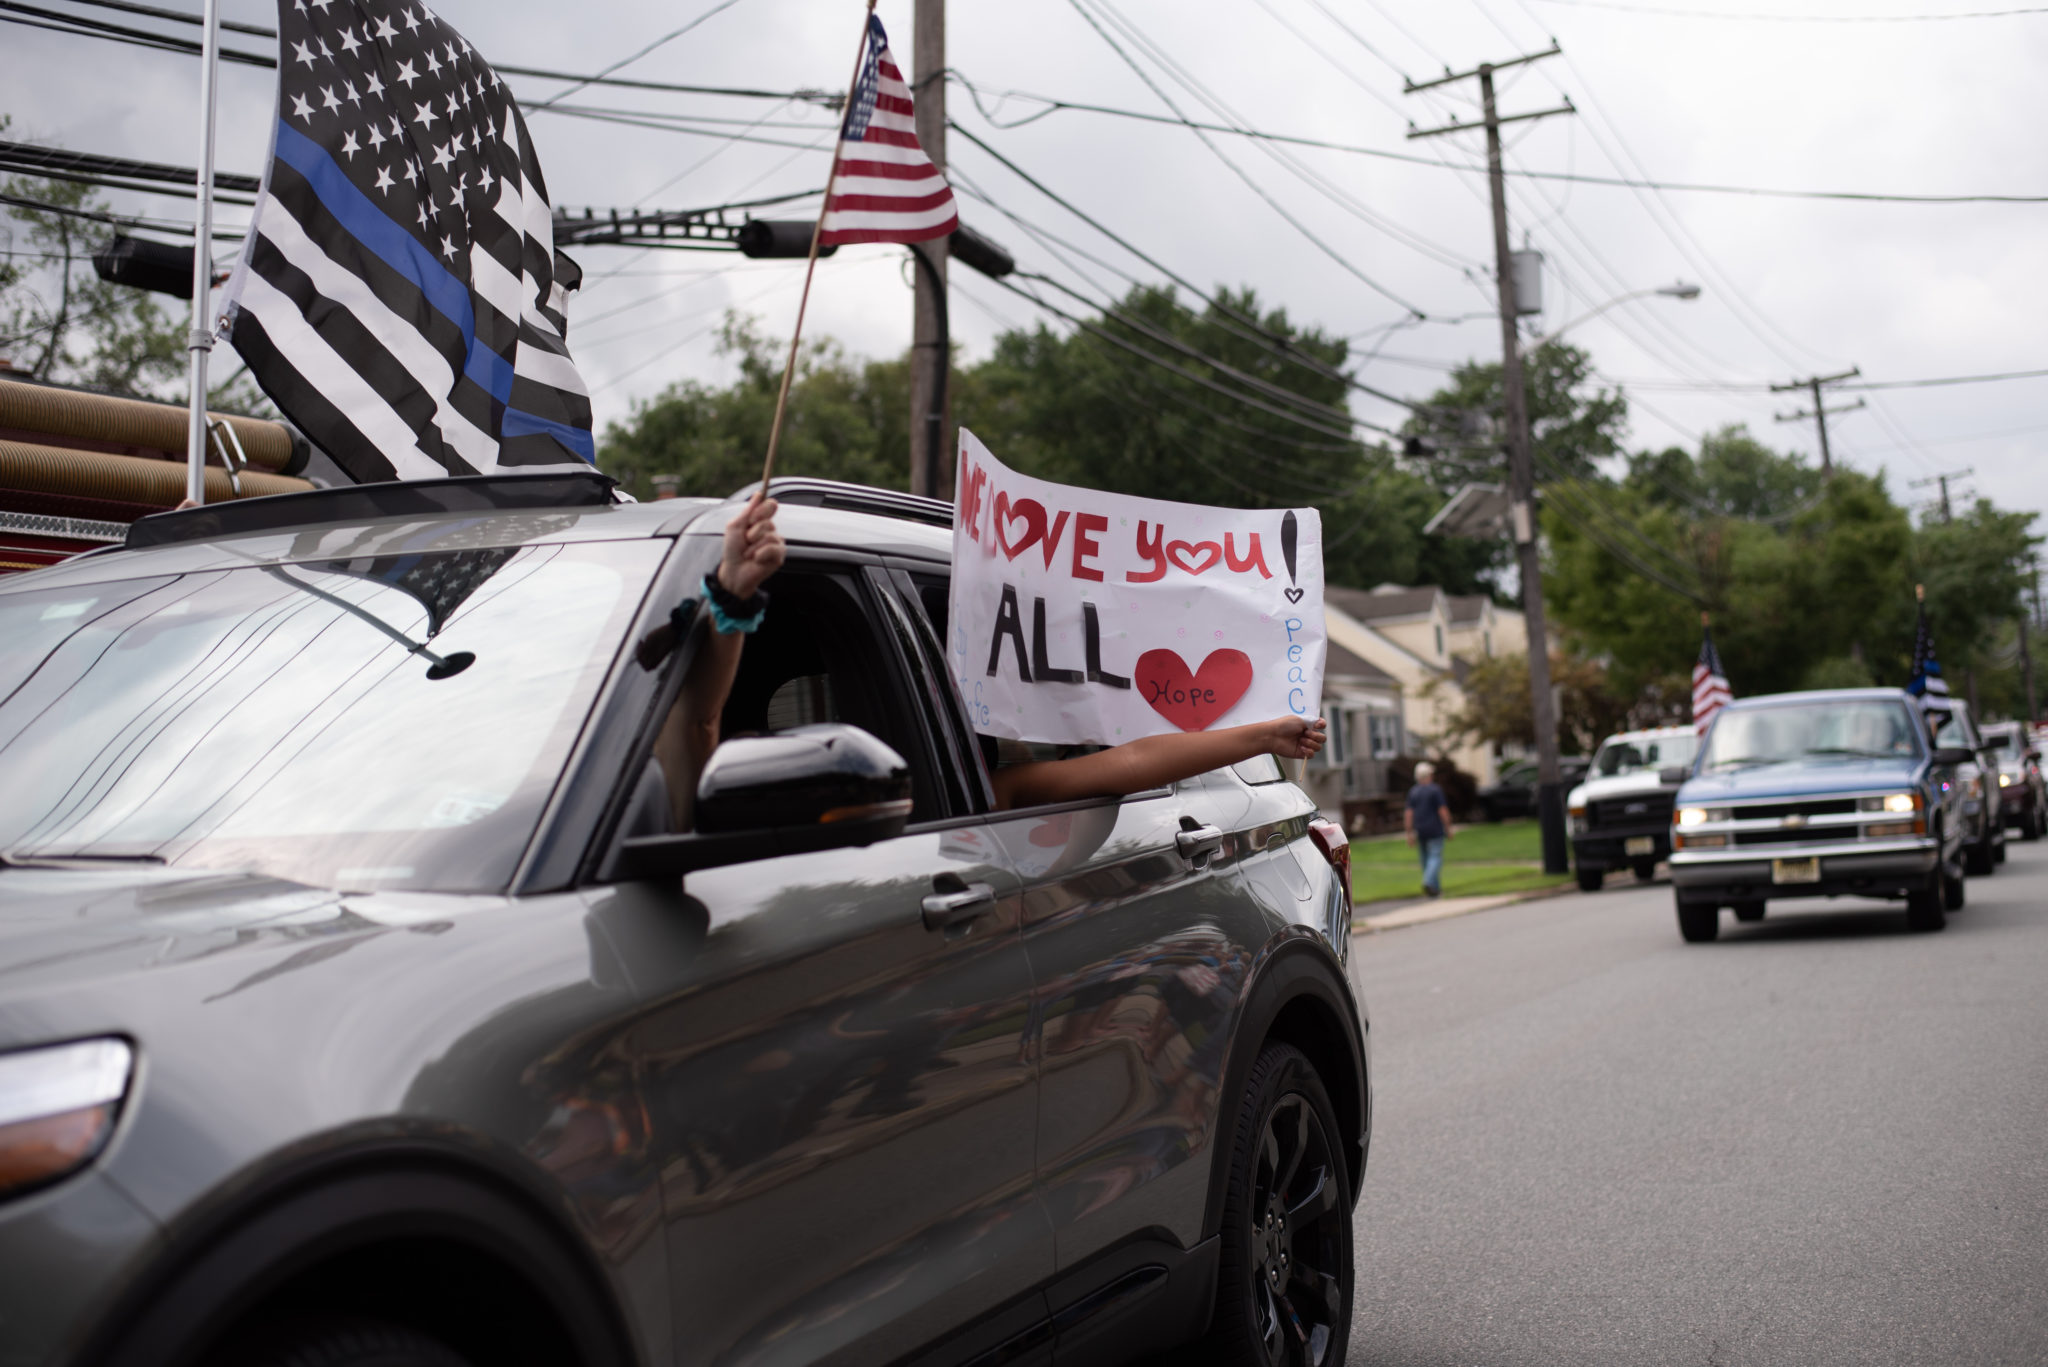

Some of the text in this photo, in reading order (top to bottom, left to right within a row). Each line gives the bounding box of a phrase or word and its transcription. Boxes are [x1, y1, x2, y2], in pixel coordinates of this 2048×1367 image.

[960, 449, 987, 545] WE
[986, 582, 1131, 690] ALL
[1284, 617, 1308, 715] Peac
[1148, 679, 1217, 708] Hope
